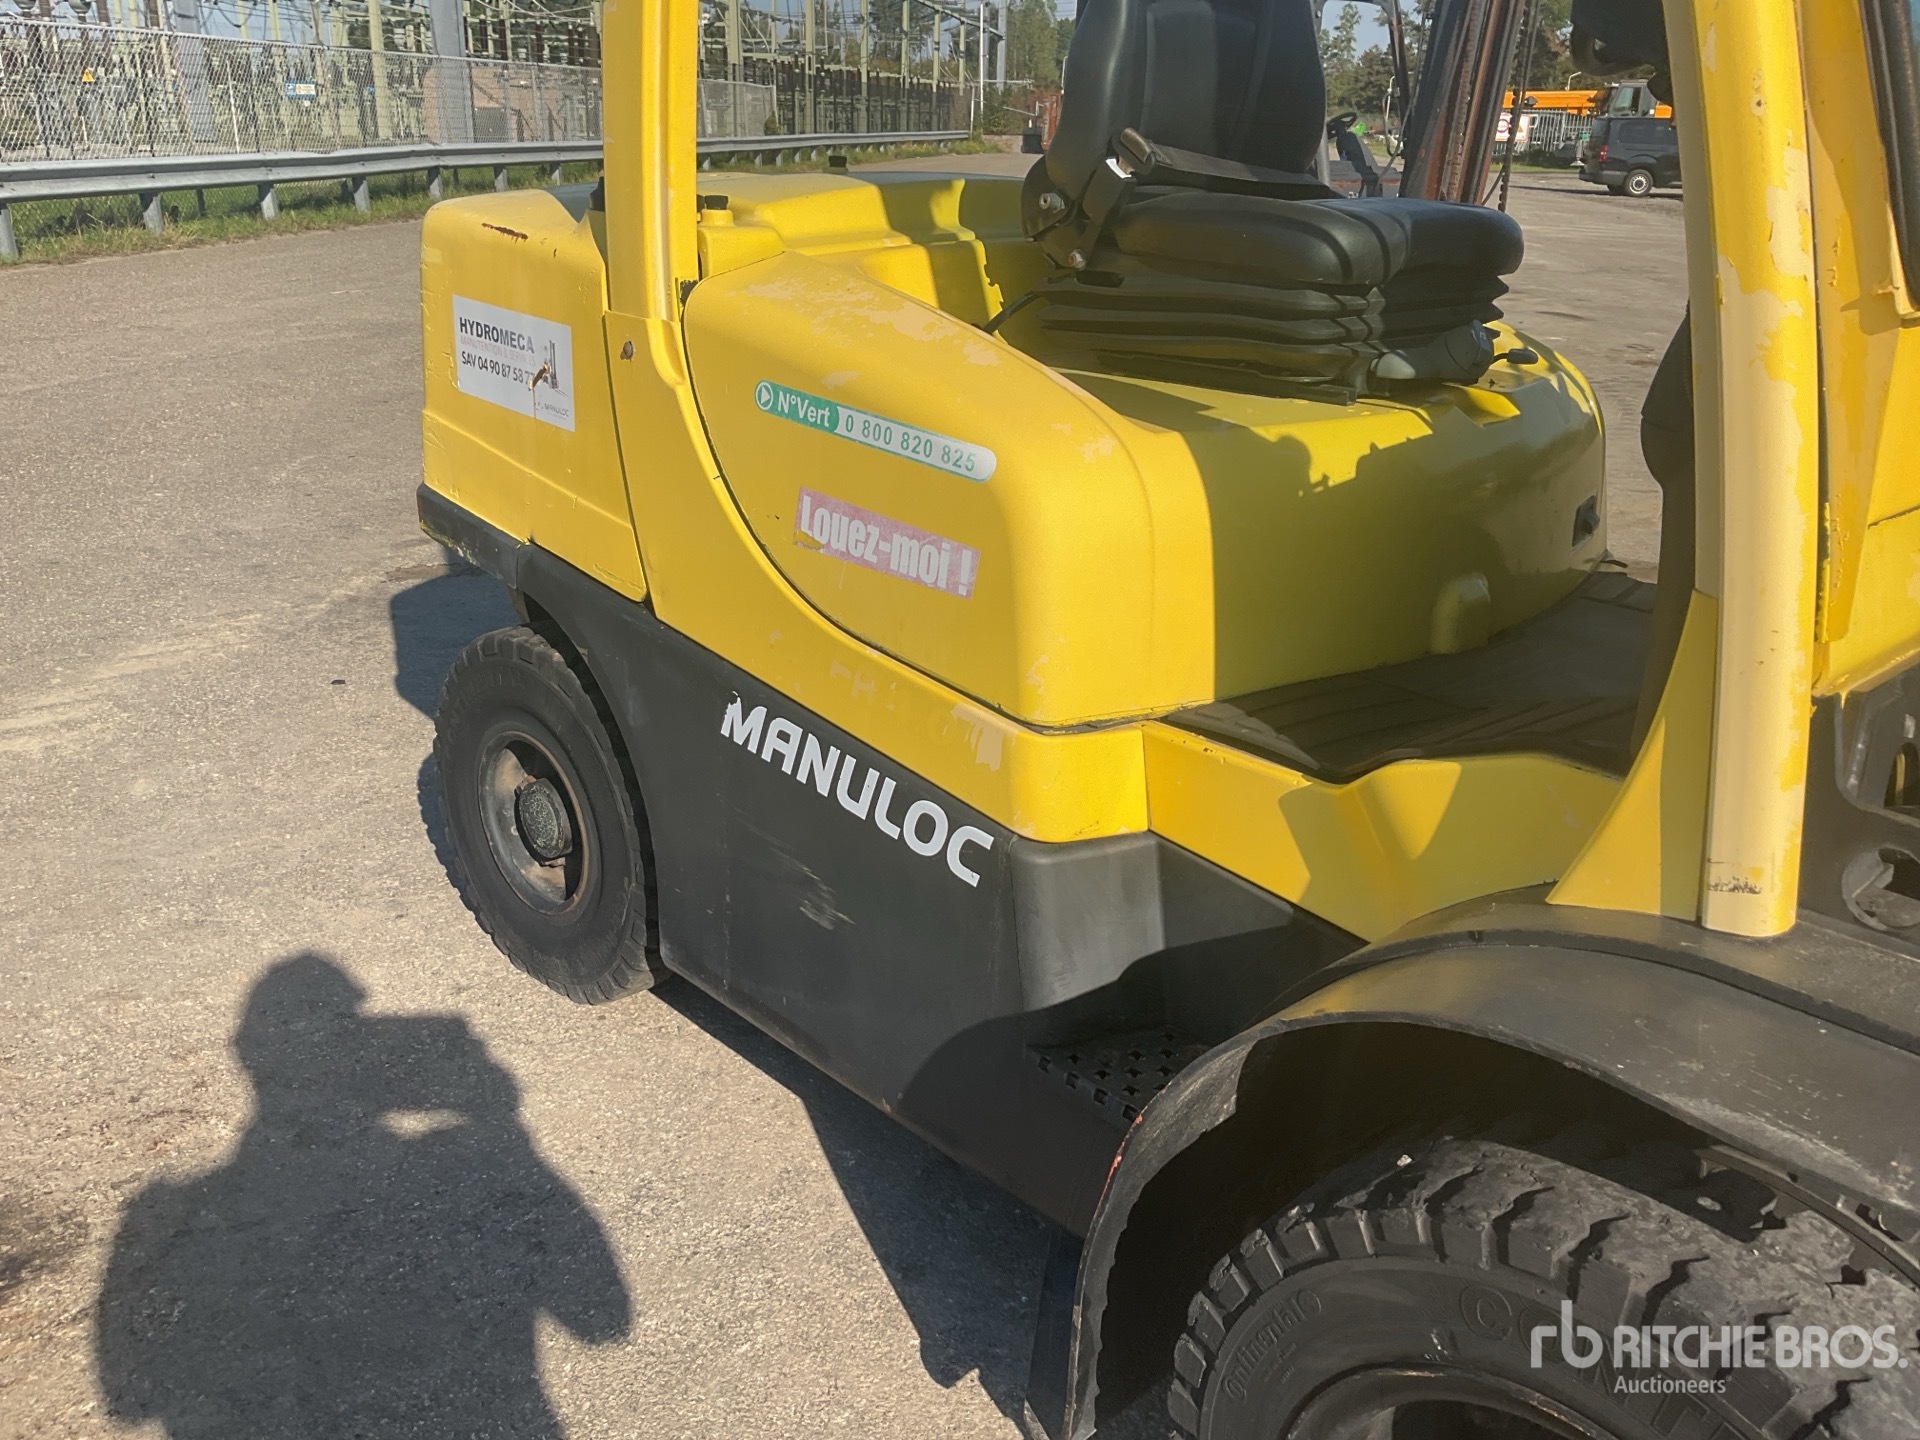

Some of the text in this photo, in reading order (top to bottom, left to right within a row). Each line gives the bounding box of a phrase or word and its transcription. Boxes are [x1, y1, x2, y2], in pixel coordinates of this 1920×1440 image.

[460, 317, 534, 354] HYDROMECA
[462, 351, 476, 368] SAV
[478, 356, 488, 371] 04
[490, 360, 500, 375] 90
[502, 363, 511, 378] 87
[513, 368, 523, 383] 58
[845, 414, 975, 472] 0 800 820 825
[800, 495, 952, 589] Louez-moi
[720, 690, 994, 888] MANULOC
